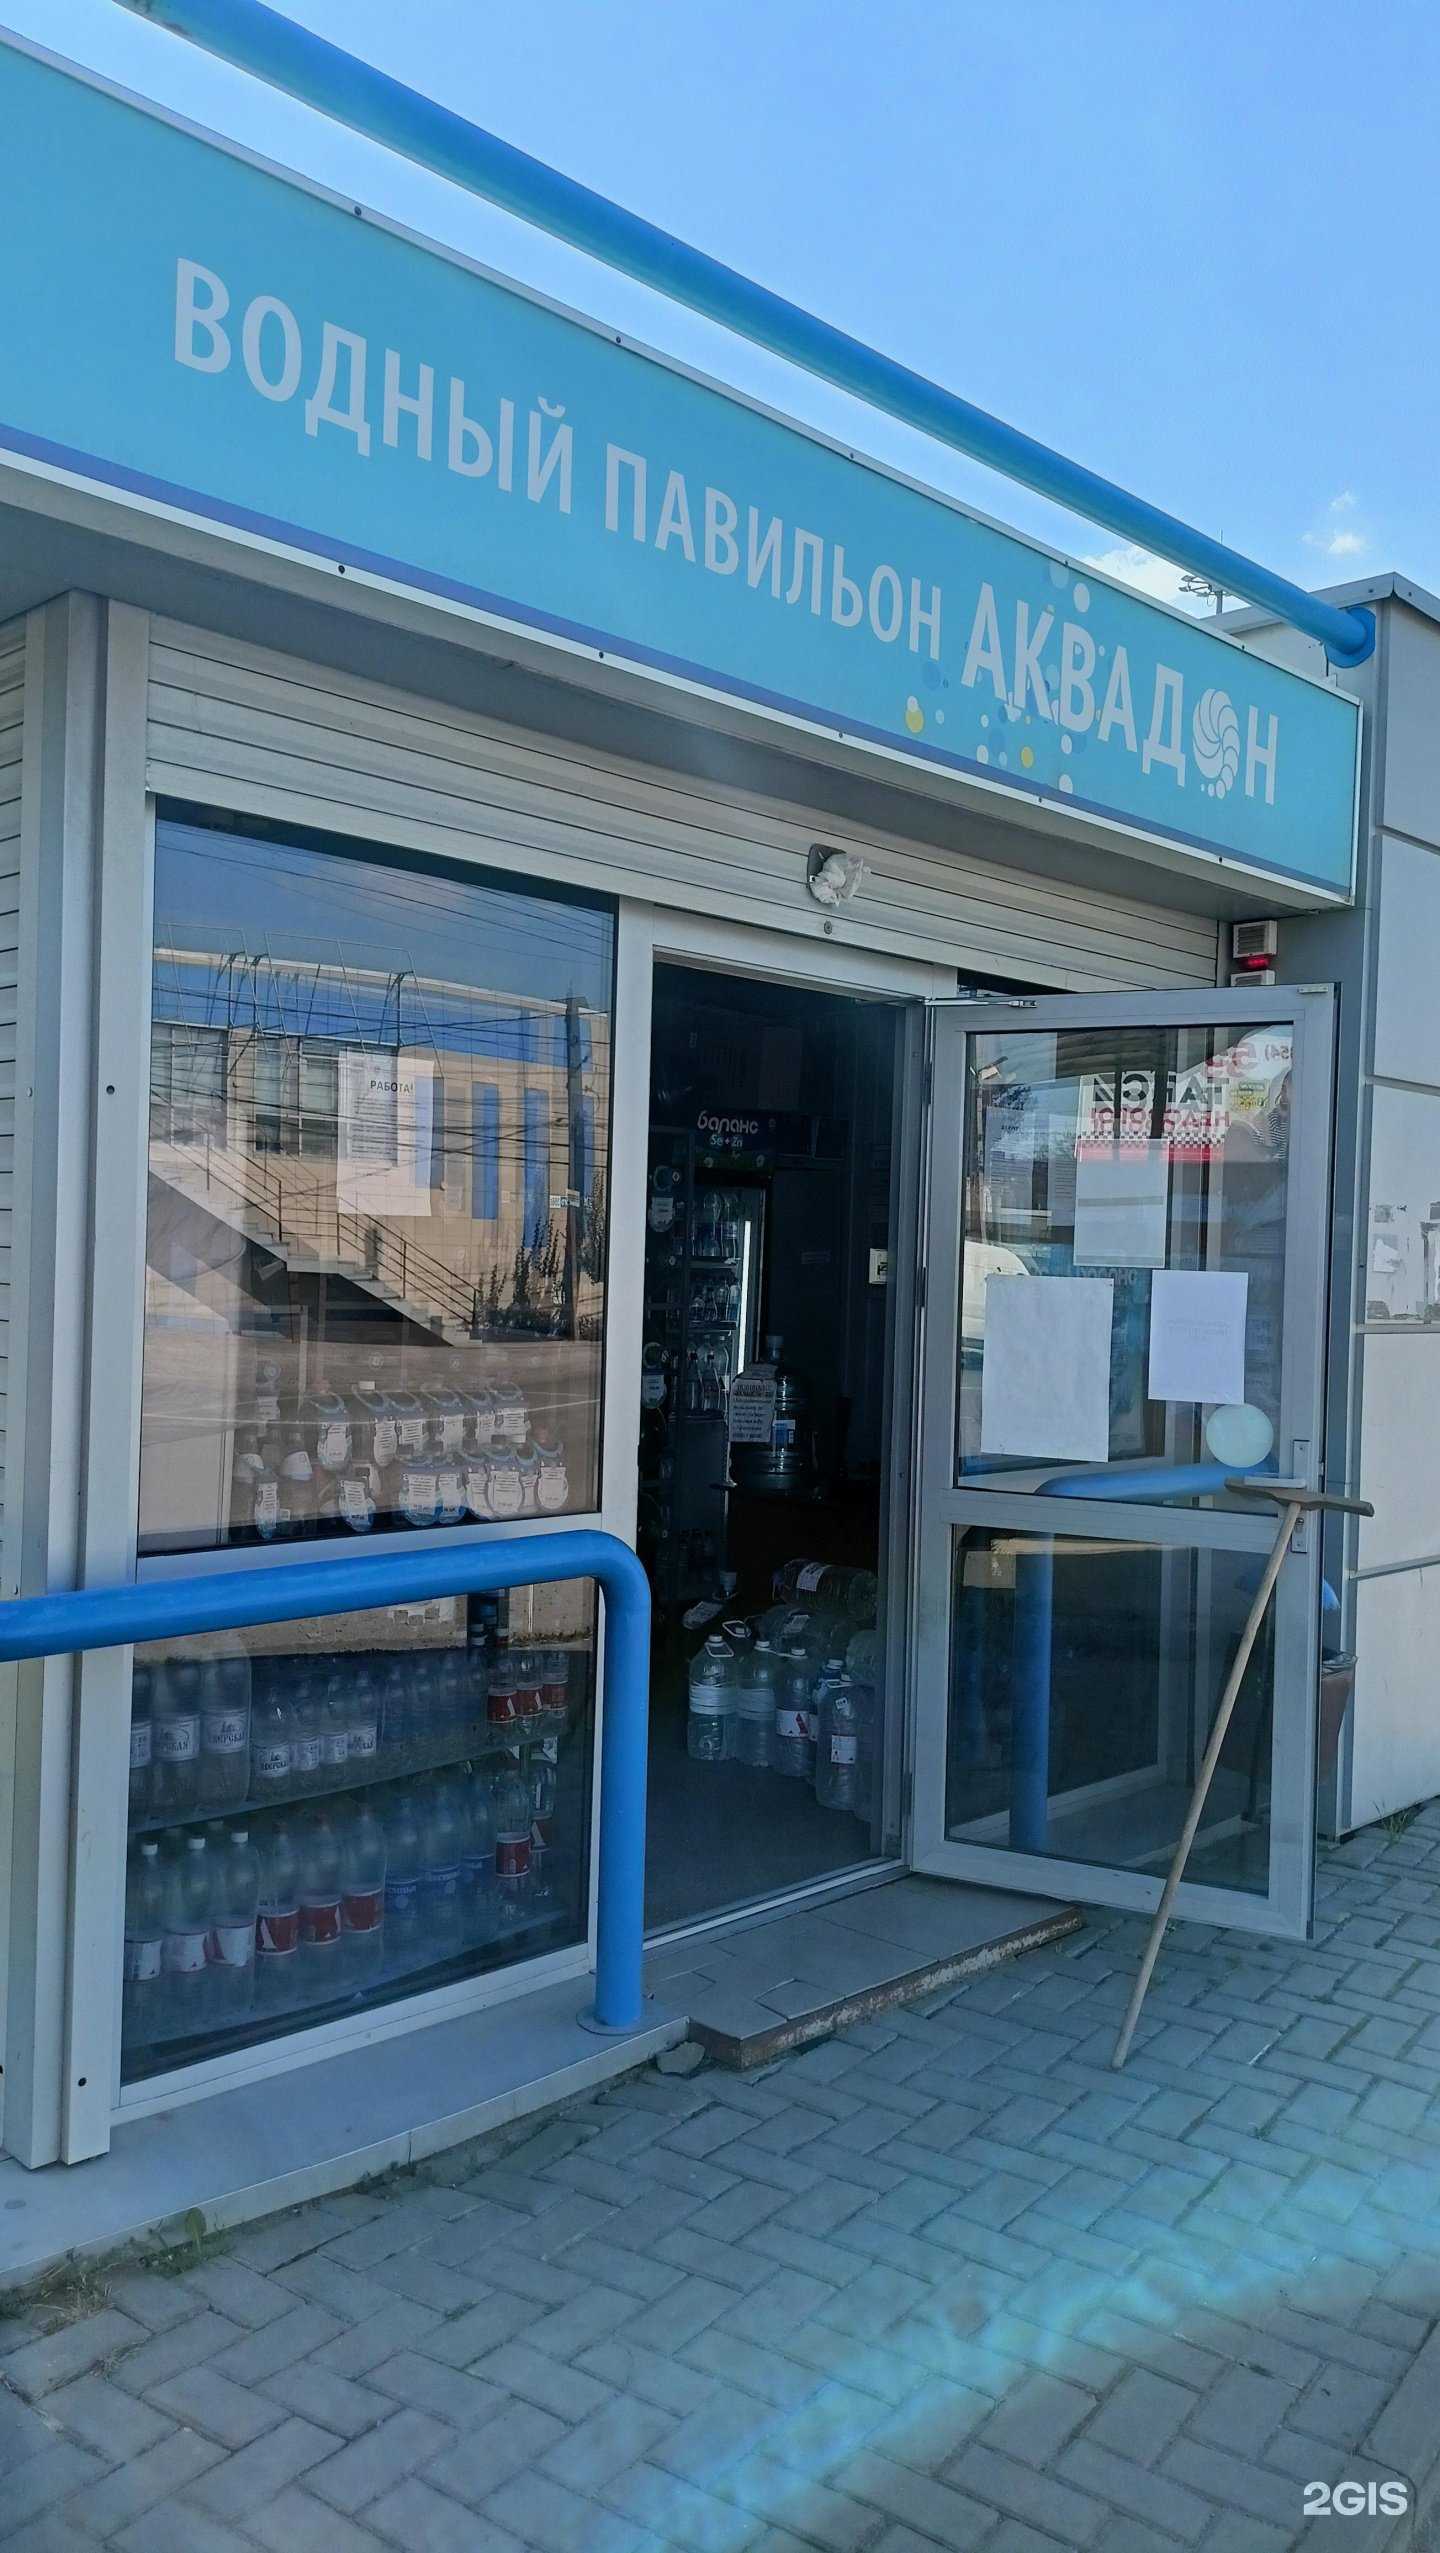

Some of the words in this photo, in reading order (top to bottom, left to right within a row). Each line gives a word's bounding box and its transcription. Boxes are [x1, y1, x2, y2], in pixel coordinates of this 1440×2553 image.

[174, 257, 574, 515] ВОДНЫЙ
[604, 443, 942, 661] ПАВИЛЬОН
[961, 582, 1279, 806] АКВАДОН
[370, 1080, 414, 1093] РАБОТА!
